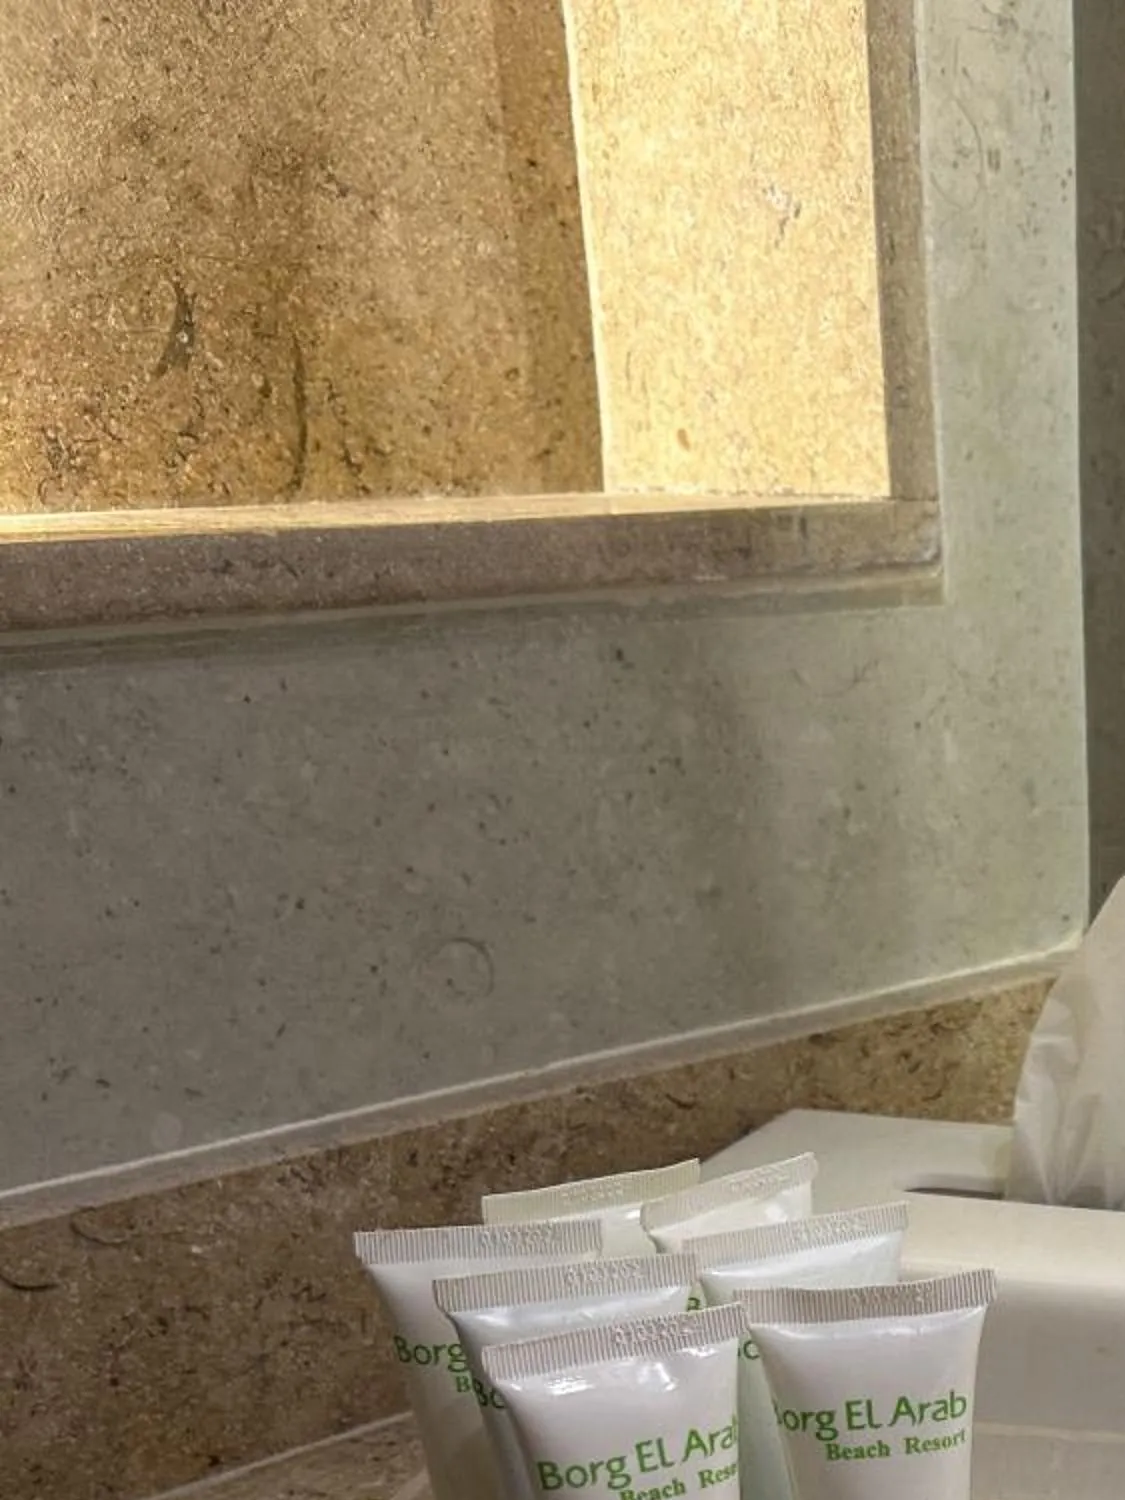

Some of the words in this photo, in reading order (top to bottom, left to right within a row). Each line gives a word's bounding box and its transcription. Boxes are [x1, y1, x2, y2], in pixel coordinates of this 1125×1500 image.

[393, 1335, 468, 1372] Borg
[887, 1389, 967, 1426] Arab
[826, 1440, 891, 1462] Beach
[903, 1429, 967, 1455] Resort
[536, 1456, 633, 1491] Borg
